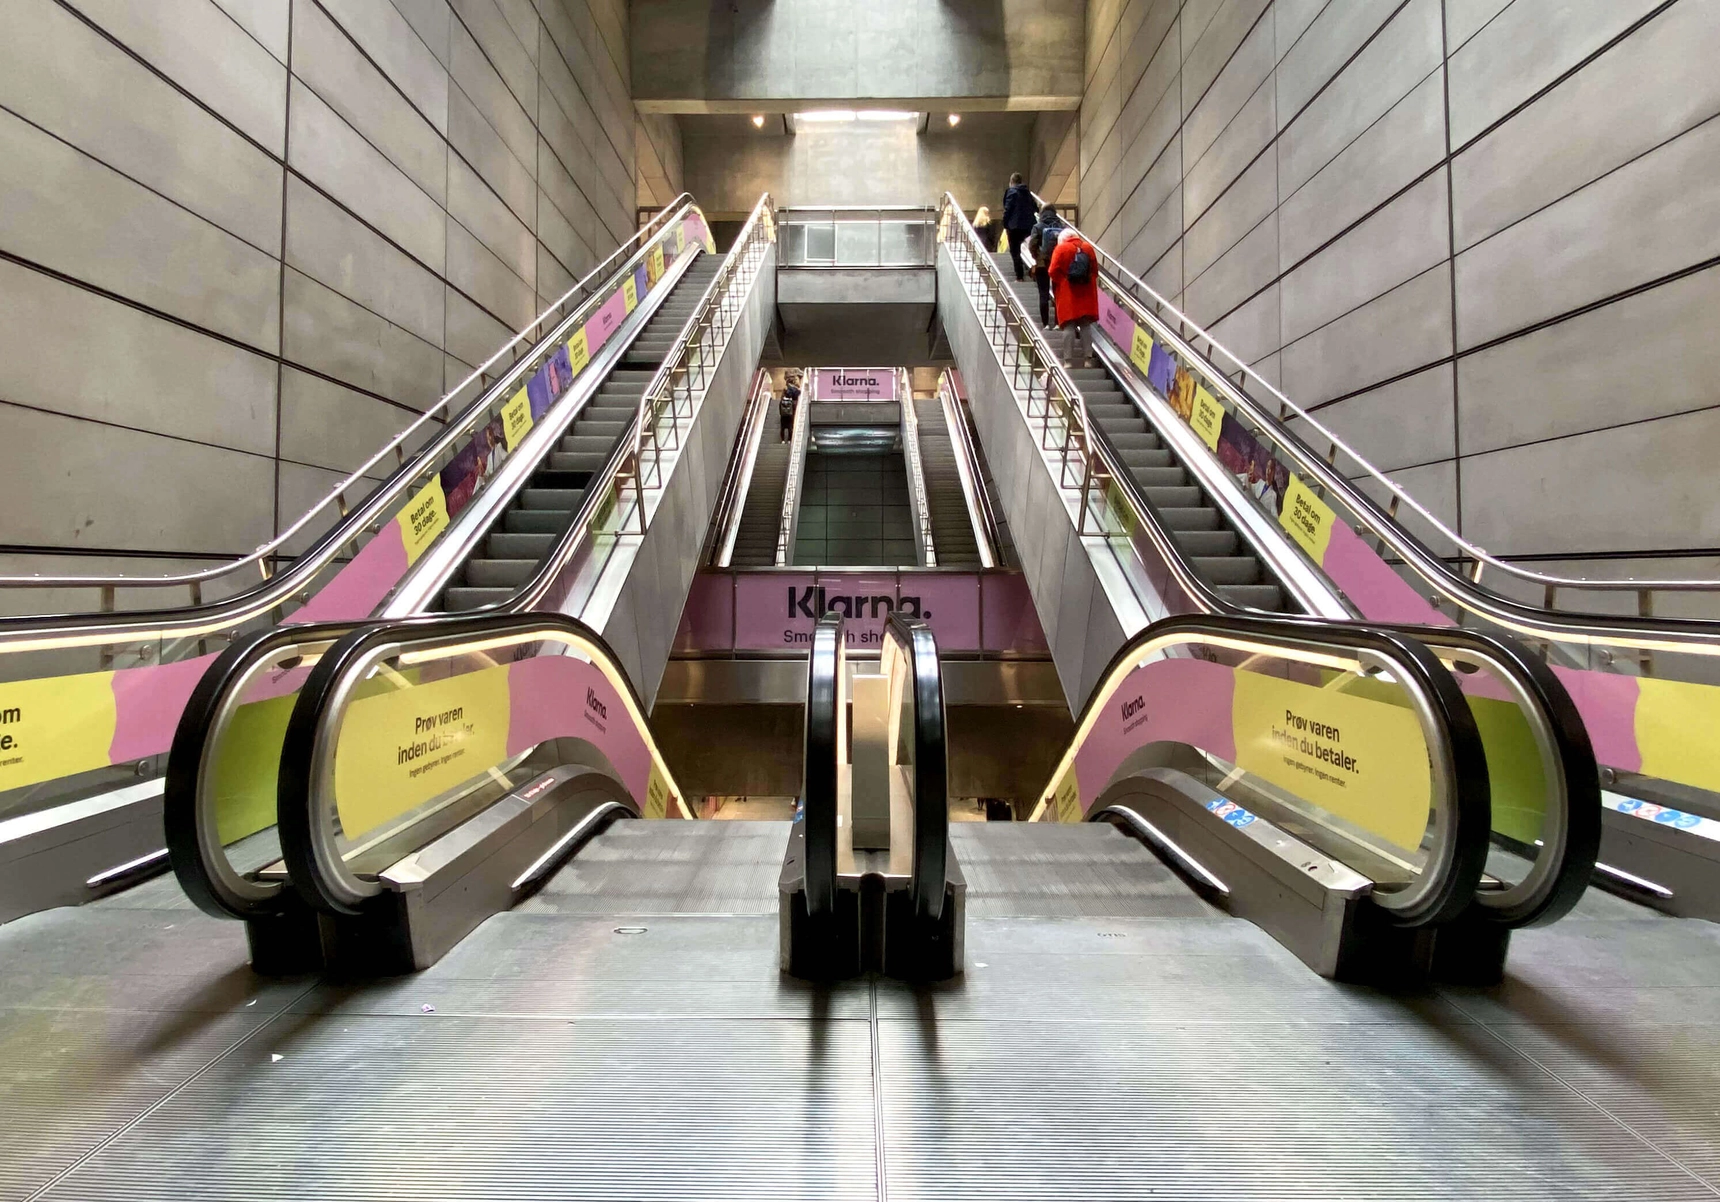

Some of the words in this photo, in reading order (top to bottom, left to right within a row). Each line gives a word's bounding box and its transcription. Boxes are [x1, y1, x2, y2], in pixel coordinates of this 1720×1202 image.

[833, 375, 880, 386] Klarna.
[410, 502, 425, 525] Betal
[425, 495, 434, 509] om
[413, 522, 422, 536] 30
[422, 509, 437, 528] dage.
[1293, 506, 1302, 520] 30
[1301, 515, 1316, 536] dage.
[1295, 493, 1311, 513] Betal
[1310, 510, 1321, 525] om
[788, 586, 932, 619] Klarna.
[0, 707, 21, 724] m
[586, 686, 608, 720] Klarna.
[1121, 695, 1146, 722] Klarna.
[415, 715, 437, 735] Prøv
[438, 707, 463, 726] varen
[1286, 709, 1308, 731] Prøv
[1309, 720, 1340, 743] varen
[398, 741, 427, 766] inden
[428, 734, 441, 752] du
[1300, 736, 1313, 756] du
[1315, 740, 1360, 774] betaler.
